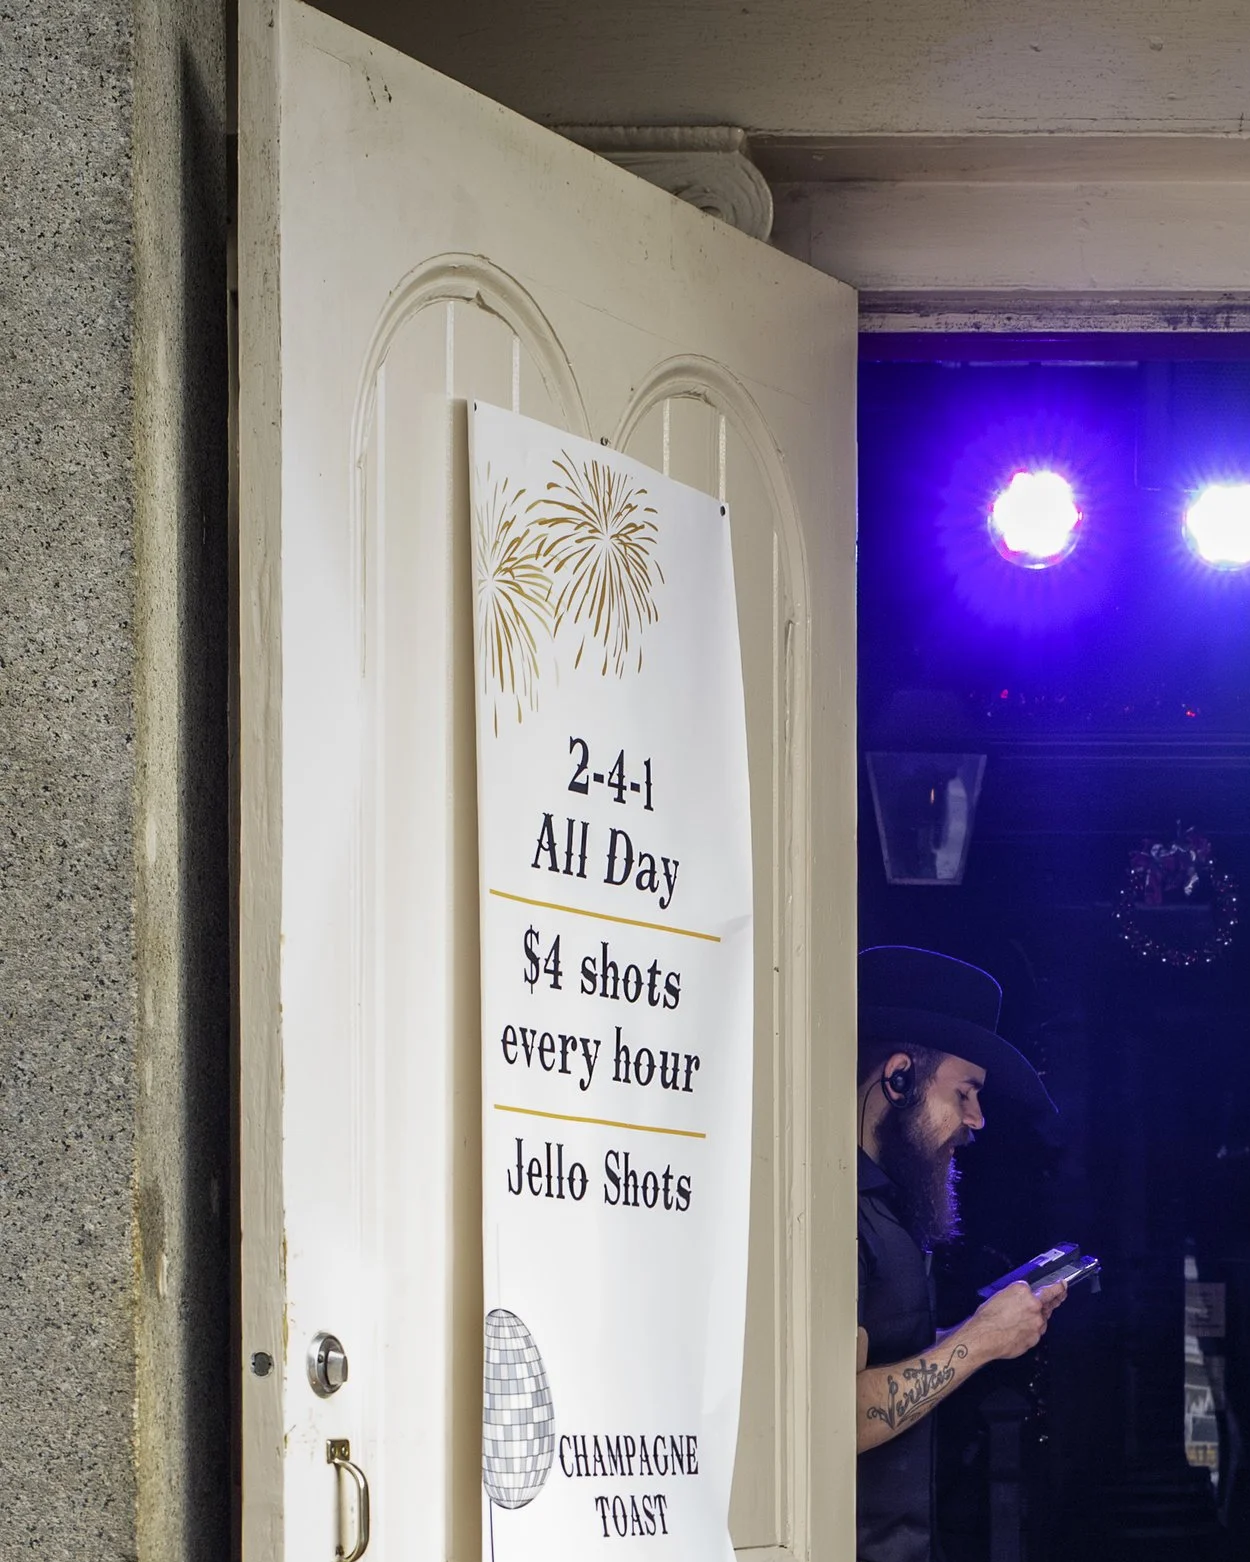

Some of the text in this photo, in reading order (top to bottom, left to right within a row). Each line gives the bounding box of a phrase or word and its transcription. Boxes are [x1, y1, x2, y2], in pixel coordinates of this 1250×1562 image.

[567, 735, 655, 812] 2-4-1
[531, 812, 681, 910] All Day
[523, 924, 682, 1010] $4 shots
[501, 1024, 701, 1093] every hour
[507, 1137, 693, 1212] Jello Shots
[558, 1434, 699, 1478] CHAMPAGNE
[594, 1493, 669, 1538] TOAST
